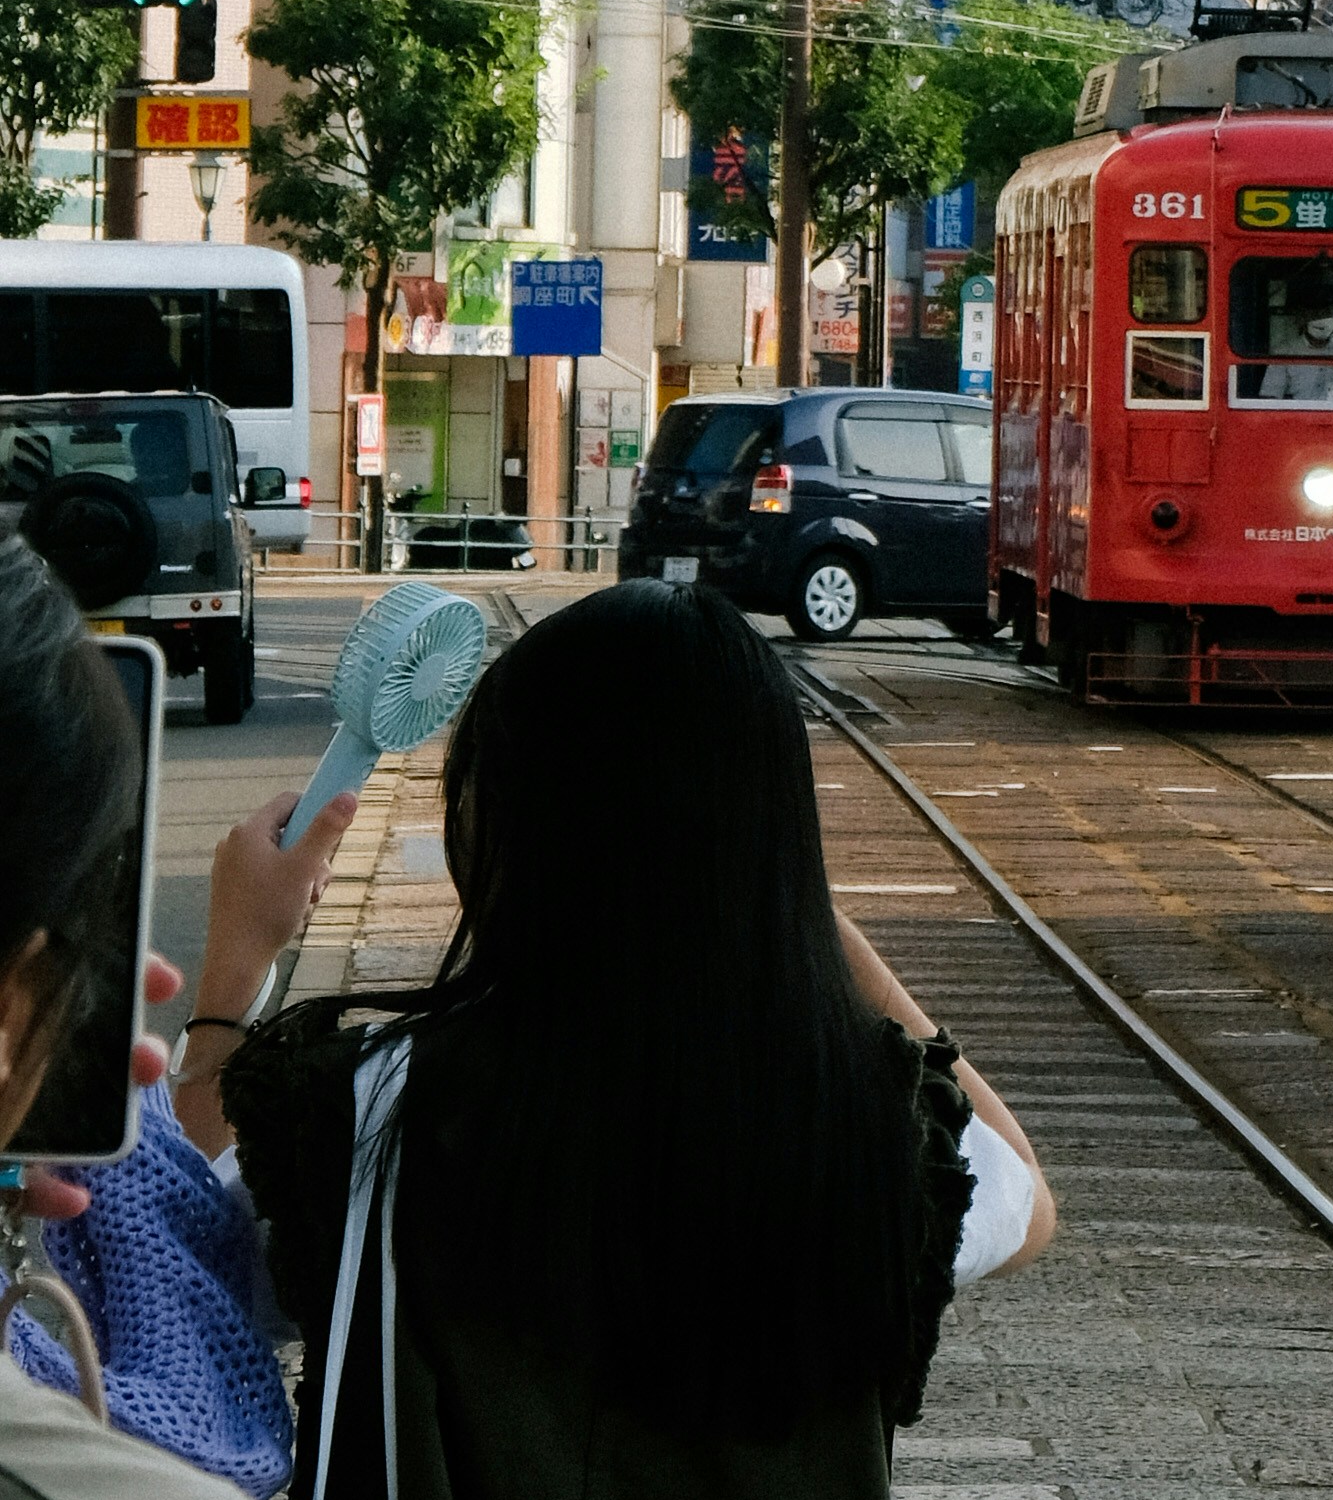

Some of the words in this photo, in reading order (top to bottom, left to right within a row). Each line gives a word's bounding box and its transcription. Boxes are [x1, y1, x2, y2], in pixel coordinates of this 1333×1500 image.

[1132, 192, 1204, 219] 361
[1243, 189, 1291, 227] 5
[396, 257, 417, 273] 6F
